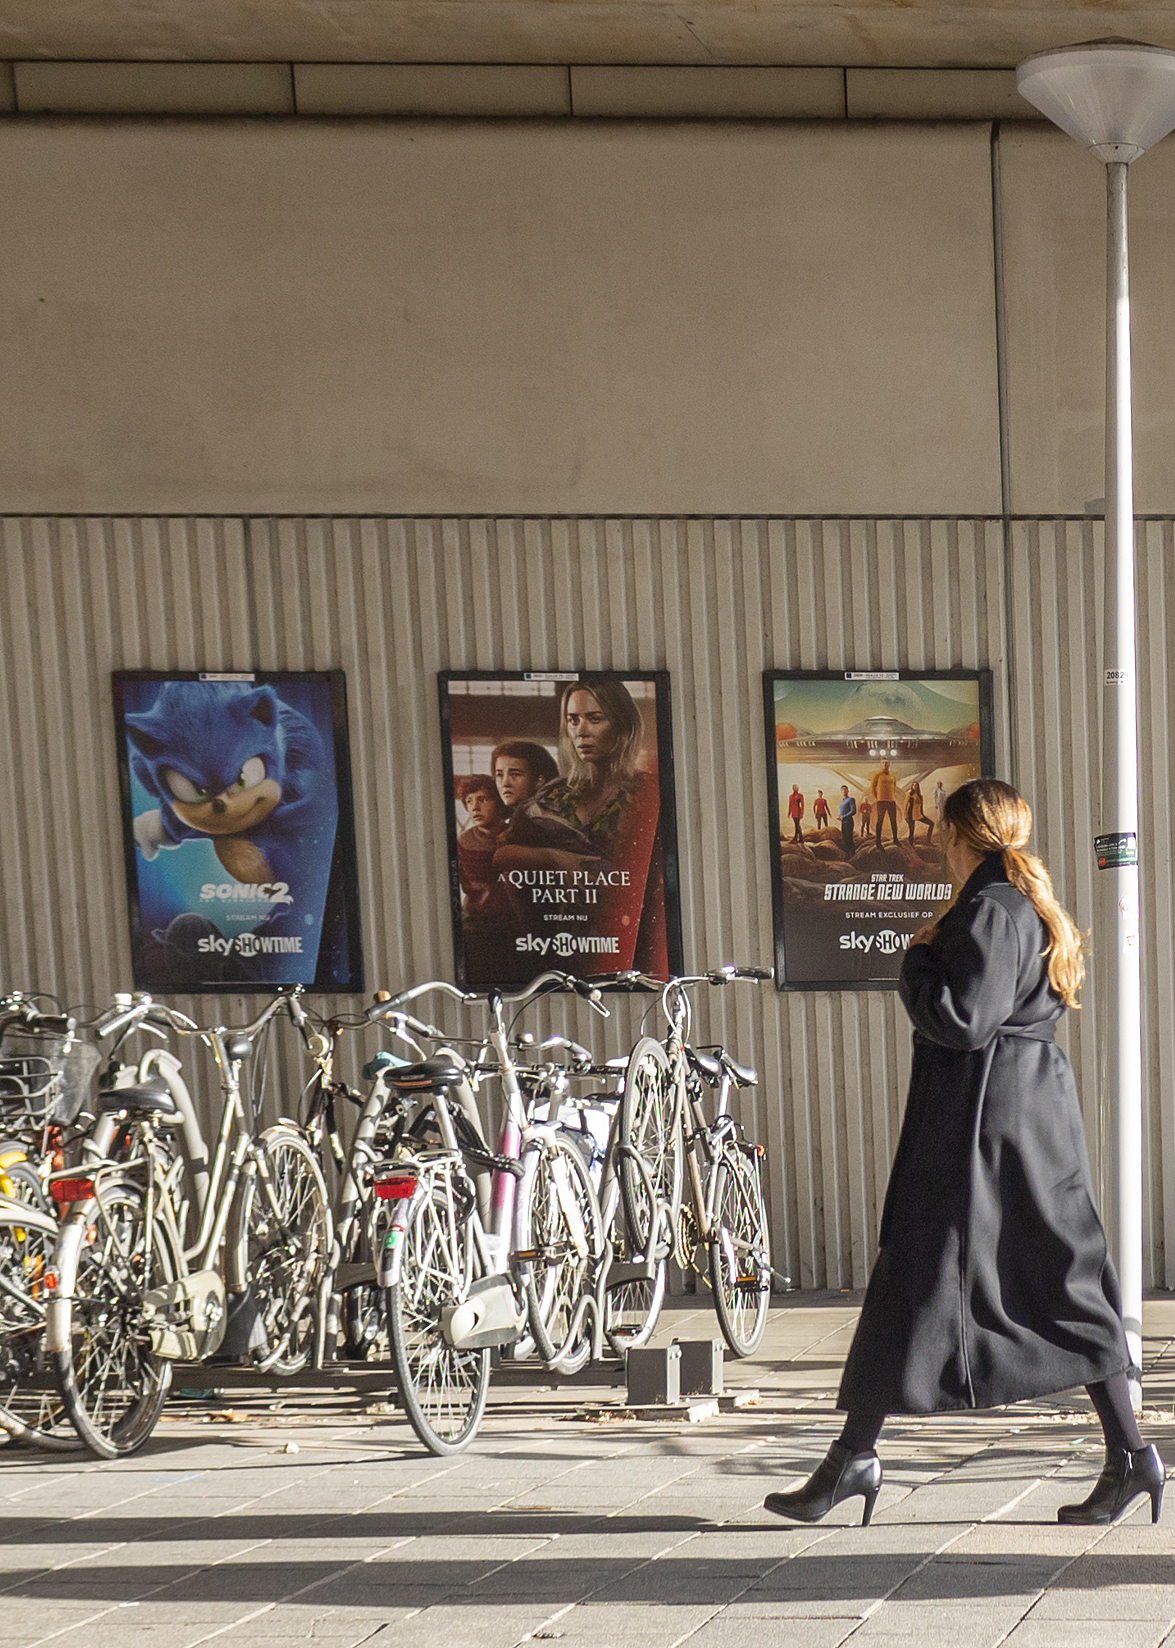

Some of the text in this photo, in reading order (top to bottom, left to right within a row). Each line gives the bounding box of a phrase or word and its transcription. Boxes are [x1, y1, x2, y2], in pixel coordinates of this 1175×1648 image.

[508, 869, 568, 889] QUIET
[572, 870, 631, 886] PLACE
[871, 873, 905, 883] STAR TREK
[532, 888, 598, 904] PART II
[823, 883, 953, 901] STRANGE NEW WORLDS
[543, 914, 588, 922] STREAM NU
[845, 911, 934, 919] STREAM EXCLUSIEF OP
